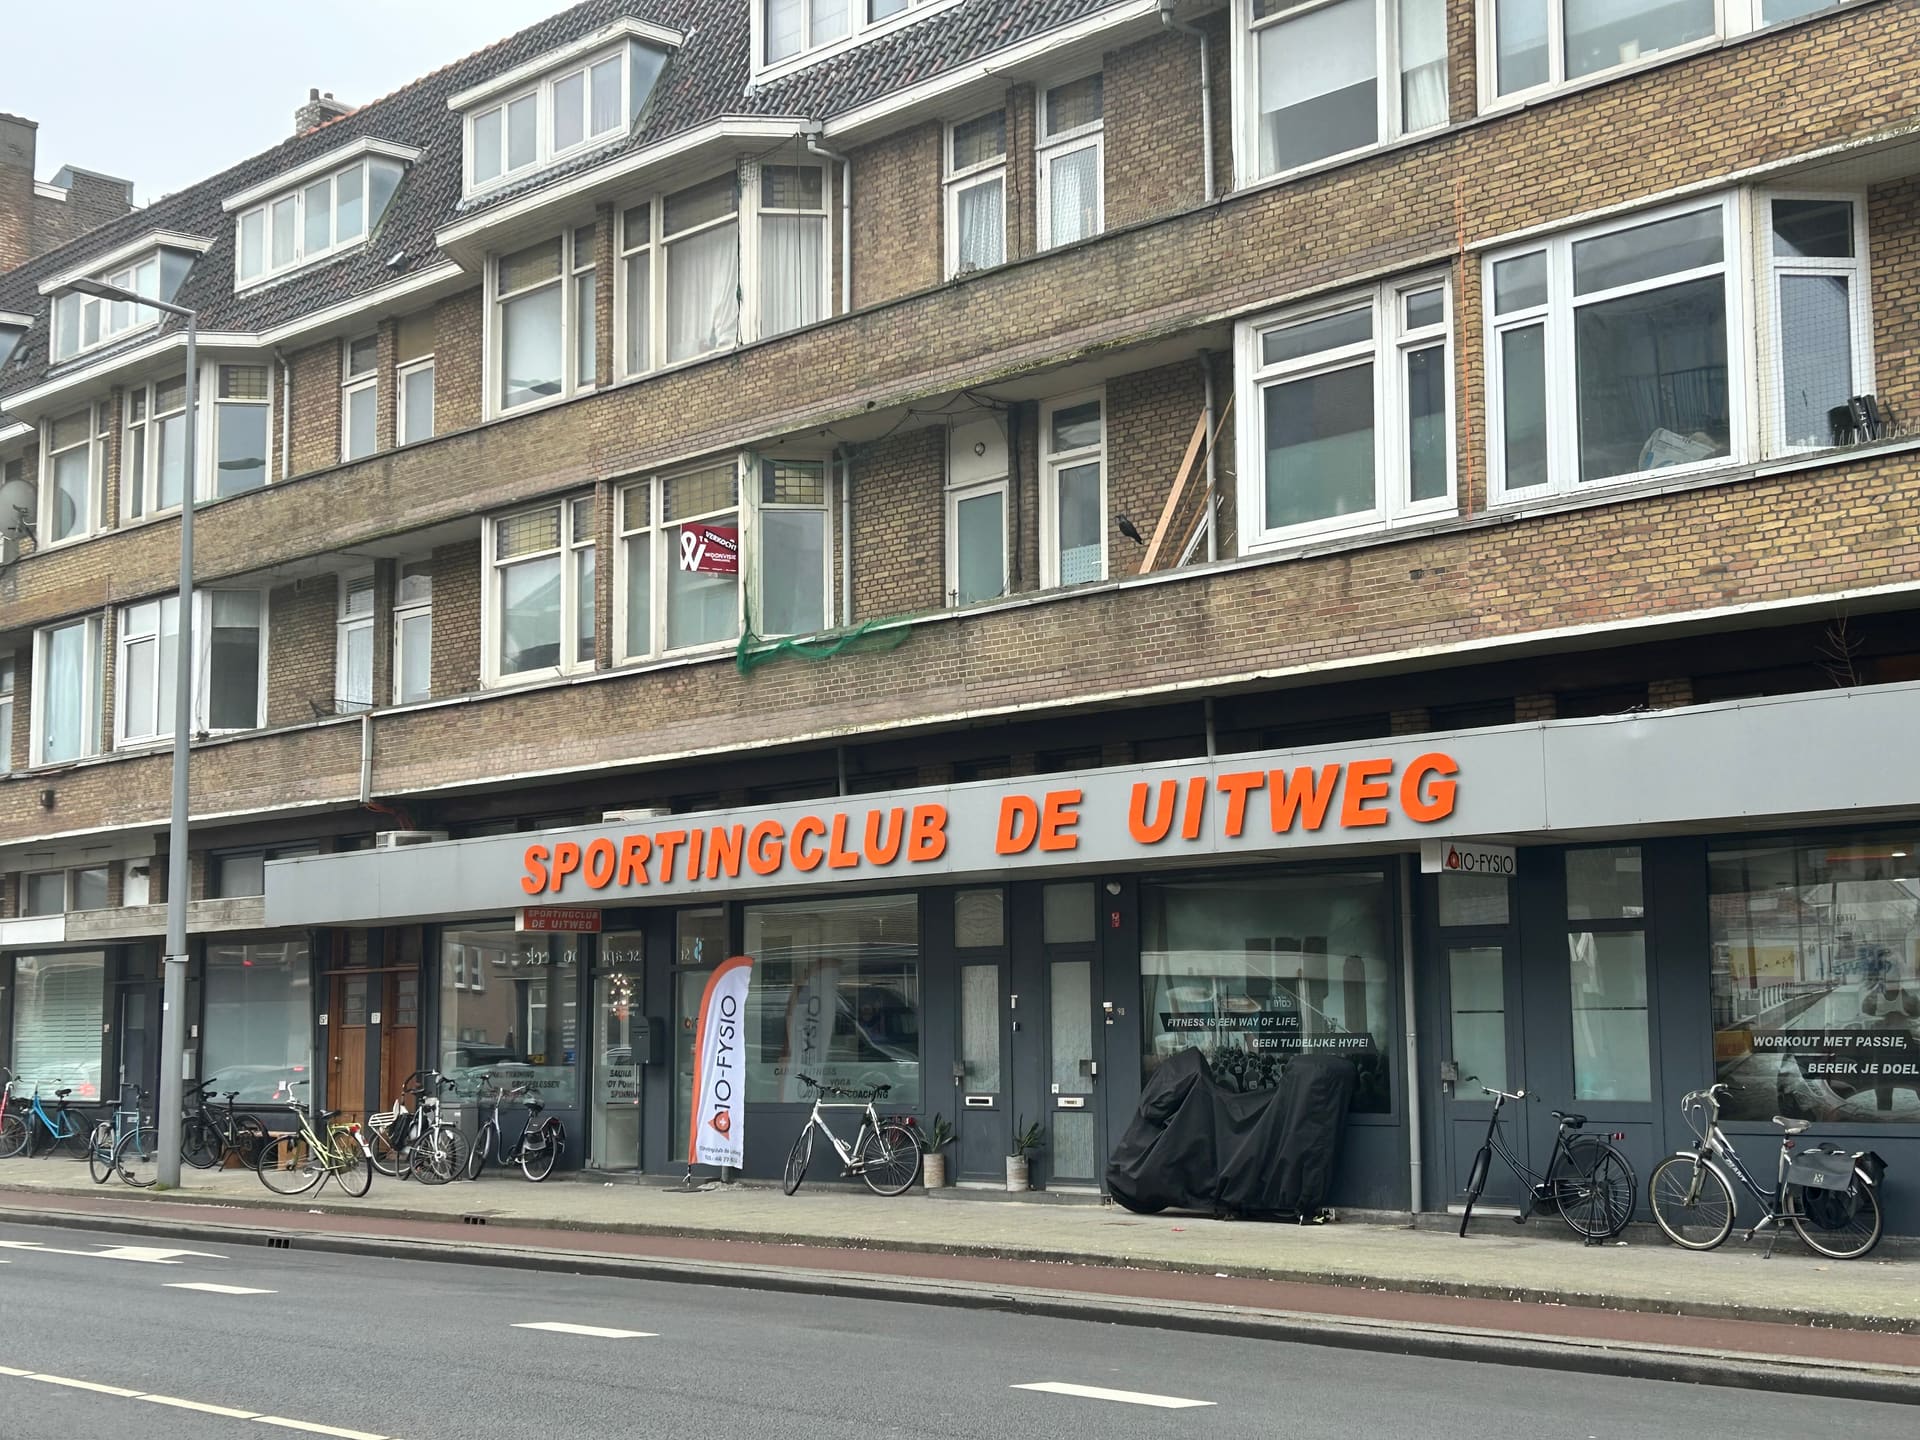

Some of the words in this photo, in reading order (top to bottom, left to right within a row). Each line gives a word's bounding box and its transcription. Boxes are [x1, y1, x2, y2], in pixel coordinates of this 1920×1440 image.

[520, 803, 948, 895] SPORTINGCLUB
[995, 789, 1083, 854] DE
[1128, 752, 1459, 844] UITWEG
[527, 909, 599, 920] SPORTINGCLUB
[531, 919, 545, 928] DE
[551, 919, 593, 929] UITWEG
[1167, 1018, 1205, 1027] FITNESS
[1207, 1018, 1216, 1026] IS
[1218, 1017, 1237, 1026] EEN
[1239, 1017, 1260, 1026] WAY
[1261, 1017, 1275, 1026] OF
[1276, 1016, 1300, 1028] LIFE,
[1252, 1038, 1278, 1048] GEEN
[1280, 1038, 1336, 1048] TIJDELIJKE
[1338, 1038, 1369, 1048] HYPE!
[1753, 1036, 1820, 1047] WORKOUT
[1823, 1036, 1852, 1047] MET
[1855, 1036, 1908, 1050] PASSIE,
[1807, 1063, 1858, 1074] BEREIK
[1861, 1063, 1879, 1074] JE
[1882, 1064, 1919, 1075] DOEL
